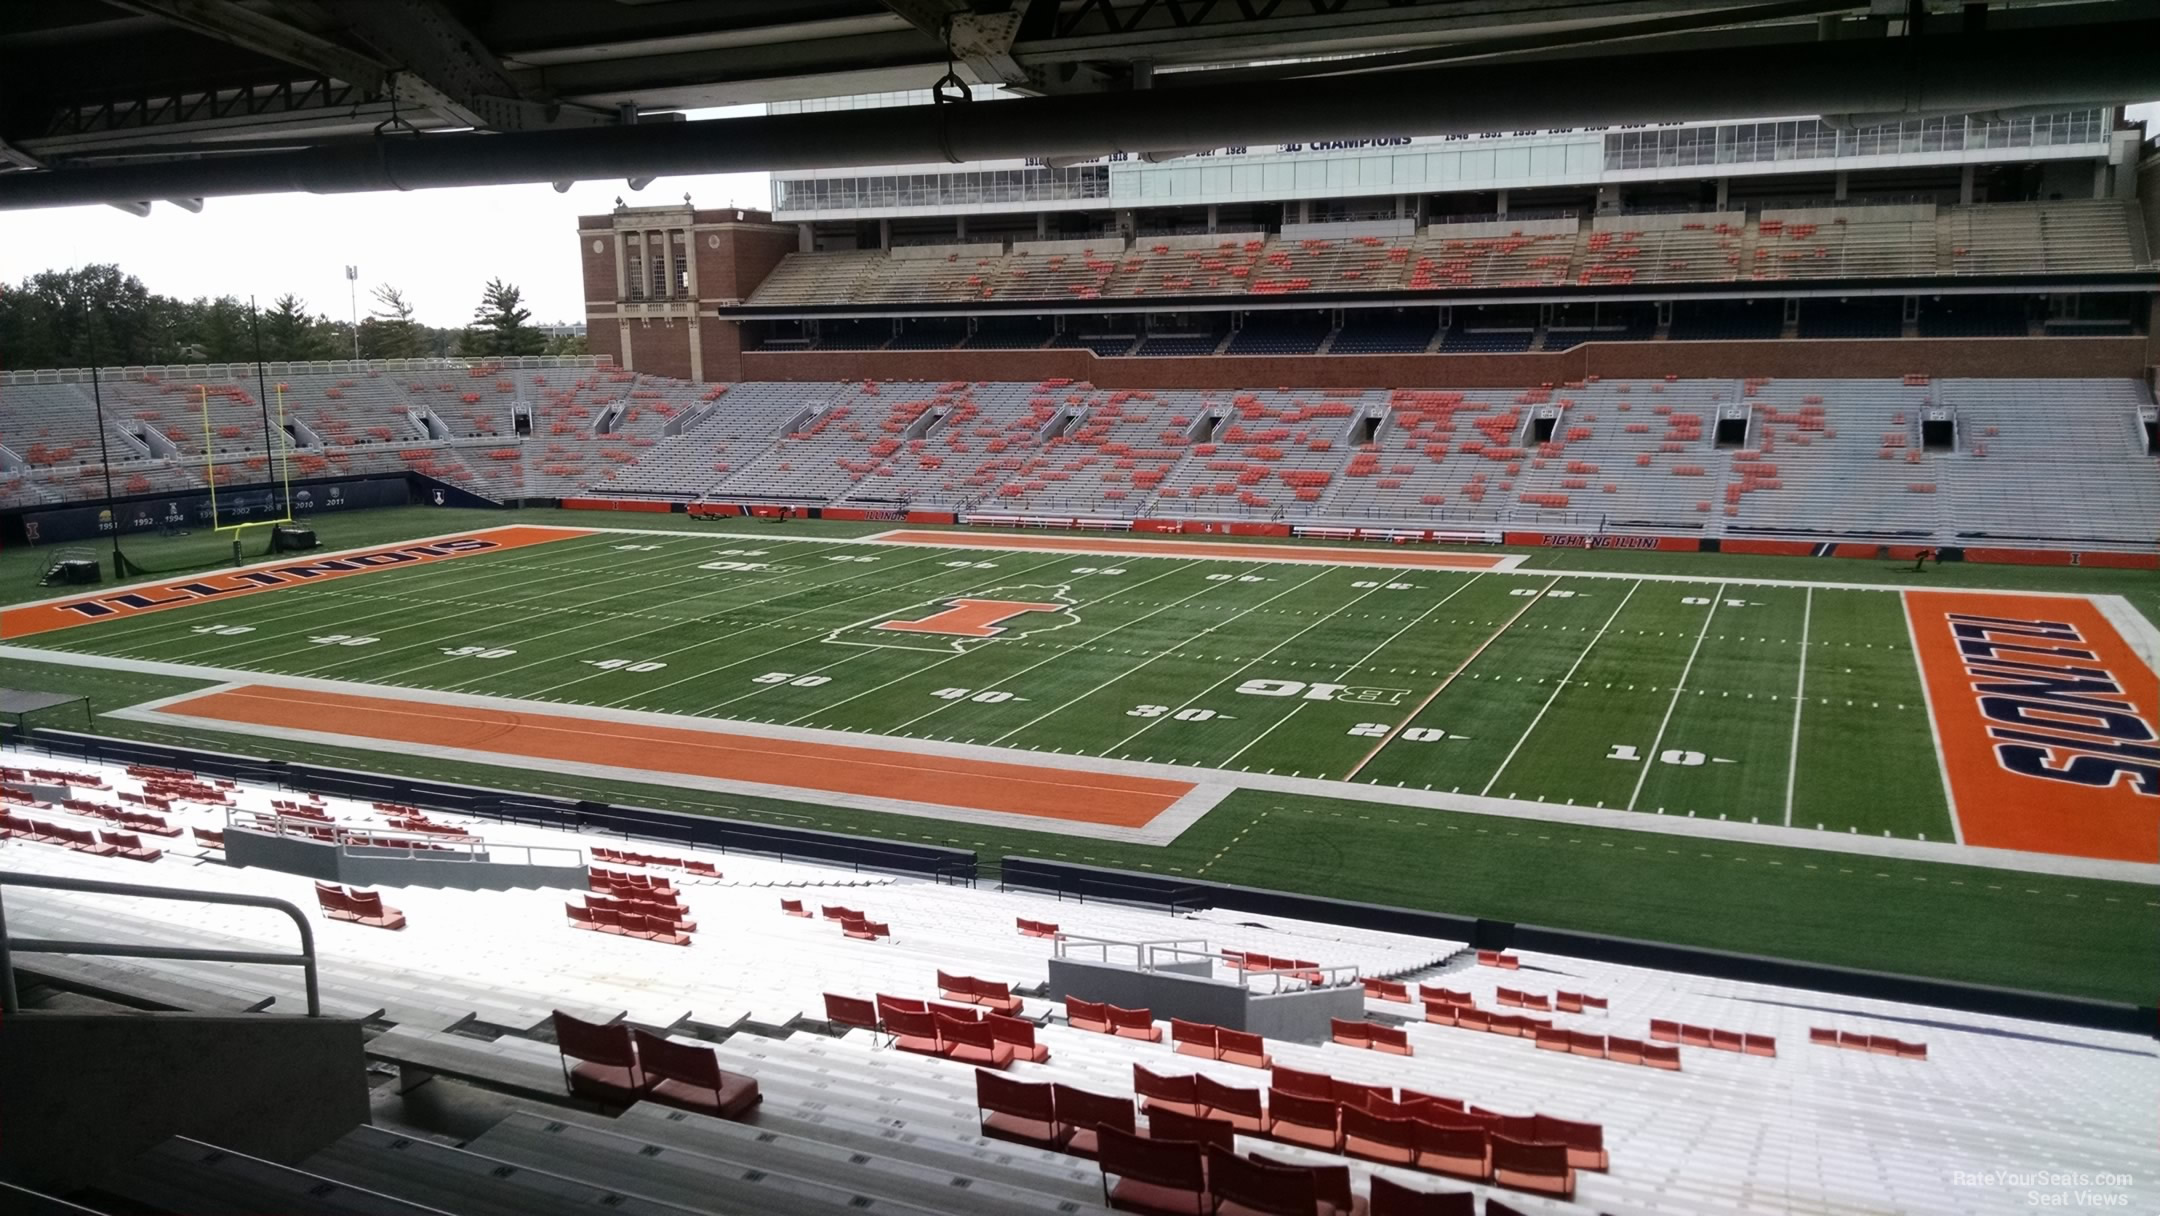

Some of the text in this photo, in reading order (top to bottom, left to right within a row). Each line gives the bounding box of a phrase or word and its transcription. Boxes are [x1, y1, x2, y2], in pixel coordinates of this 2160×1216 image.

[1310, 136, 1412, 151] CHAMPIONS
[326, 498, 344, 506] 2011
[134, 517, 153, 527] 1992
[165, 514, 184, 523] 1994
[864, 510, 908, 521] ILLINOIS
[1614, 536, 1660, 549] ILLINI
[54, 538, 502, 619] ILLINOIS
[590, 658, 668, 673] 40
[751, 671, 833, 688] 50
[929, 687, 1015, 704] 40
[1944, 612, 2160, 797] ILLINOIS
[1125, 704, 1217, 722] 30
[1347, 722, 1446, 743] 20
[1606, 744, 1707, 767] 10
